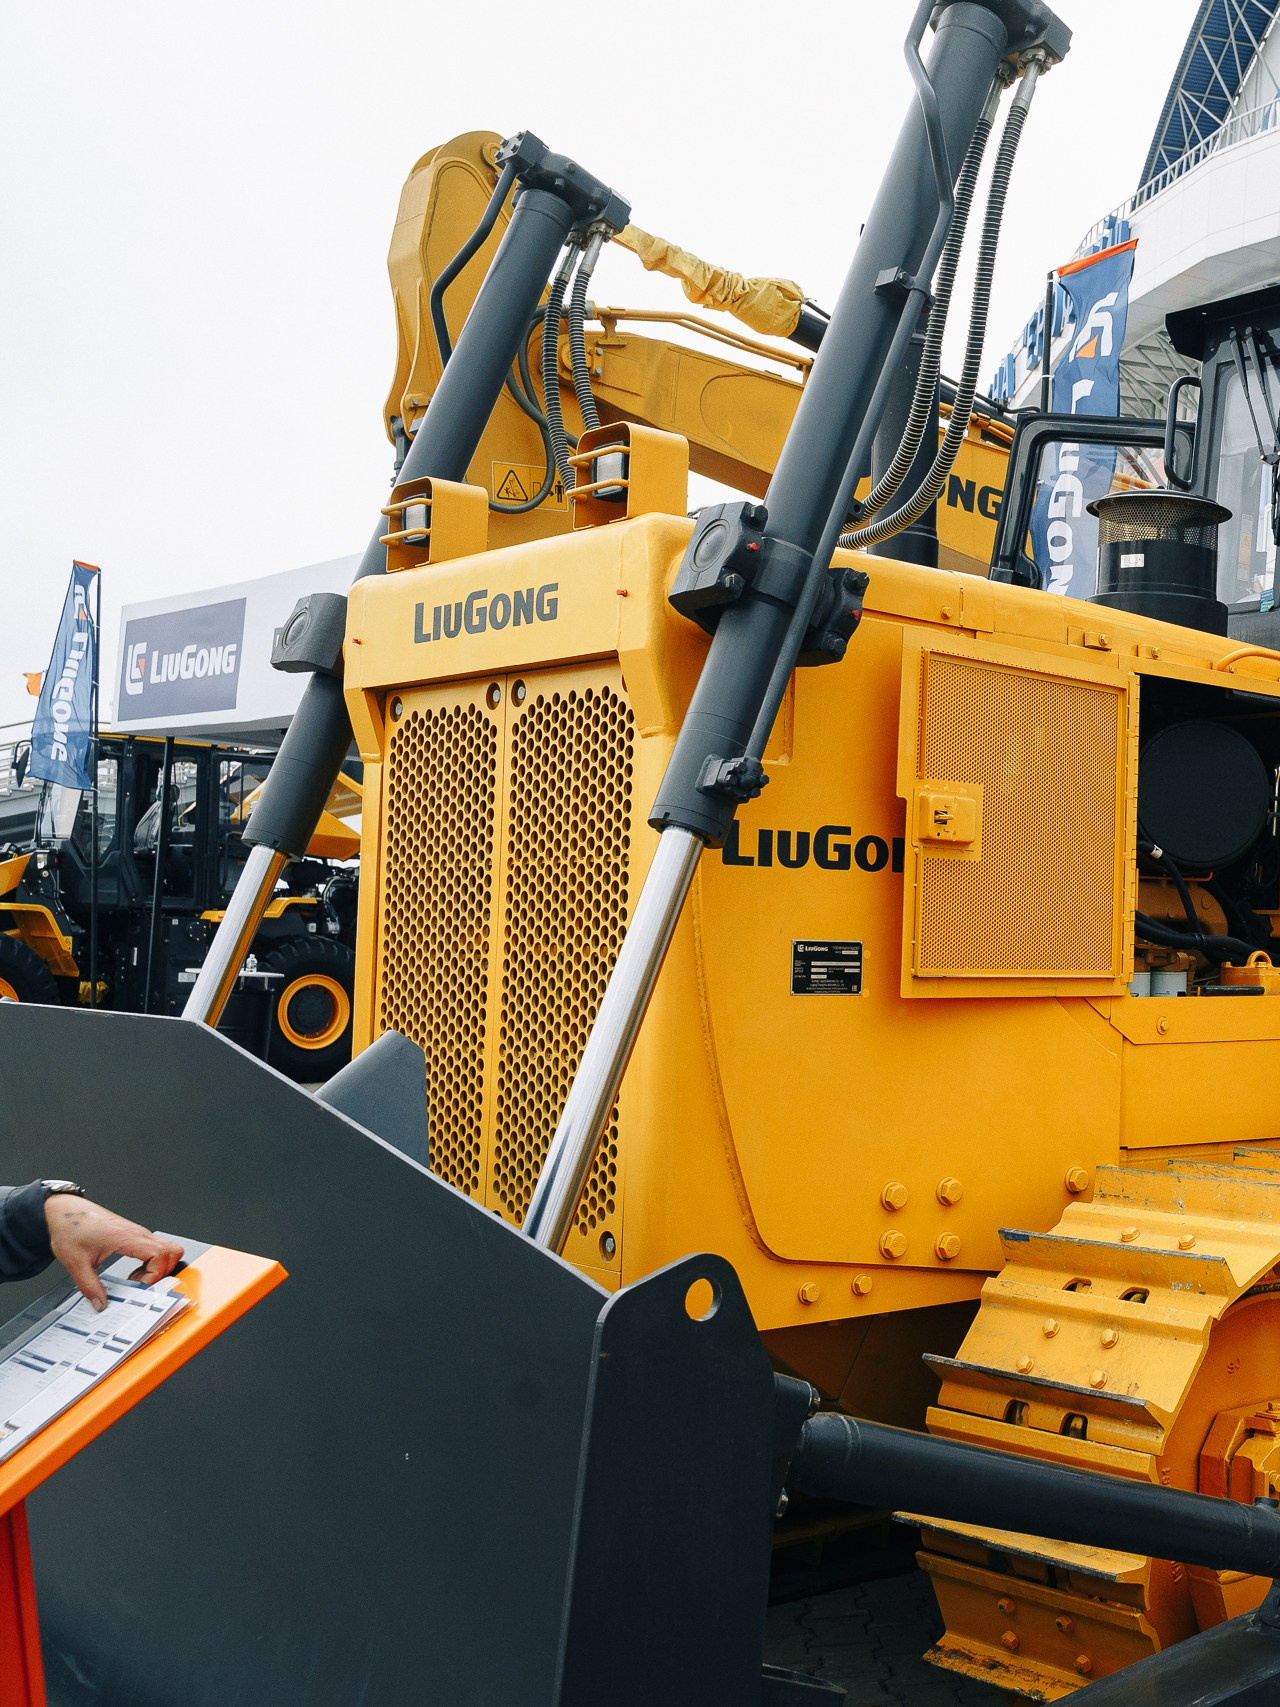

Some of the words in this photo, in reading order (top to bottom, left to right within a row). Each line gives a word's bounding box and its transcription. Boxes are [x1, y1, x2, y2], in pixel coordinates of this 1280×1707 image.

[414, 582, 559, 644] LIUGONG
[150, 643, 237, 684] LIUGONG
[722, 819, 905, 873] LIUGO
